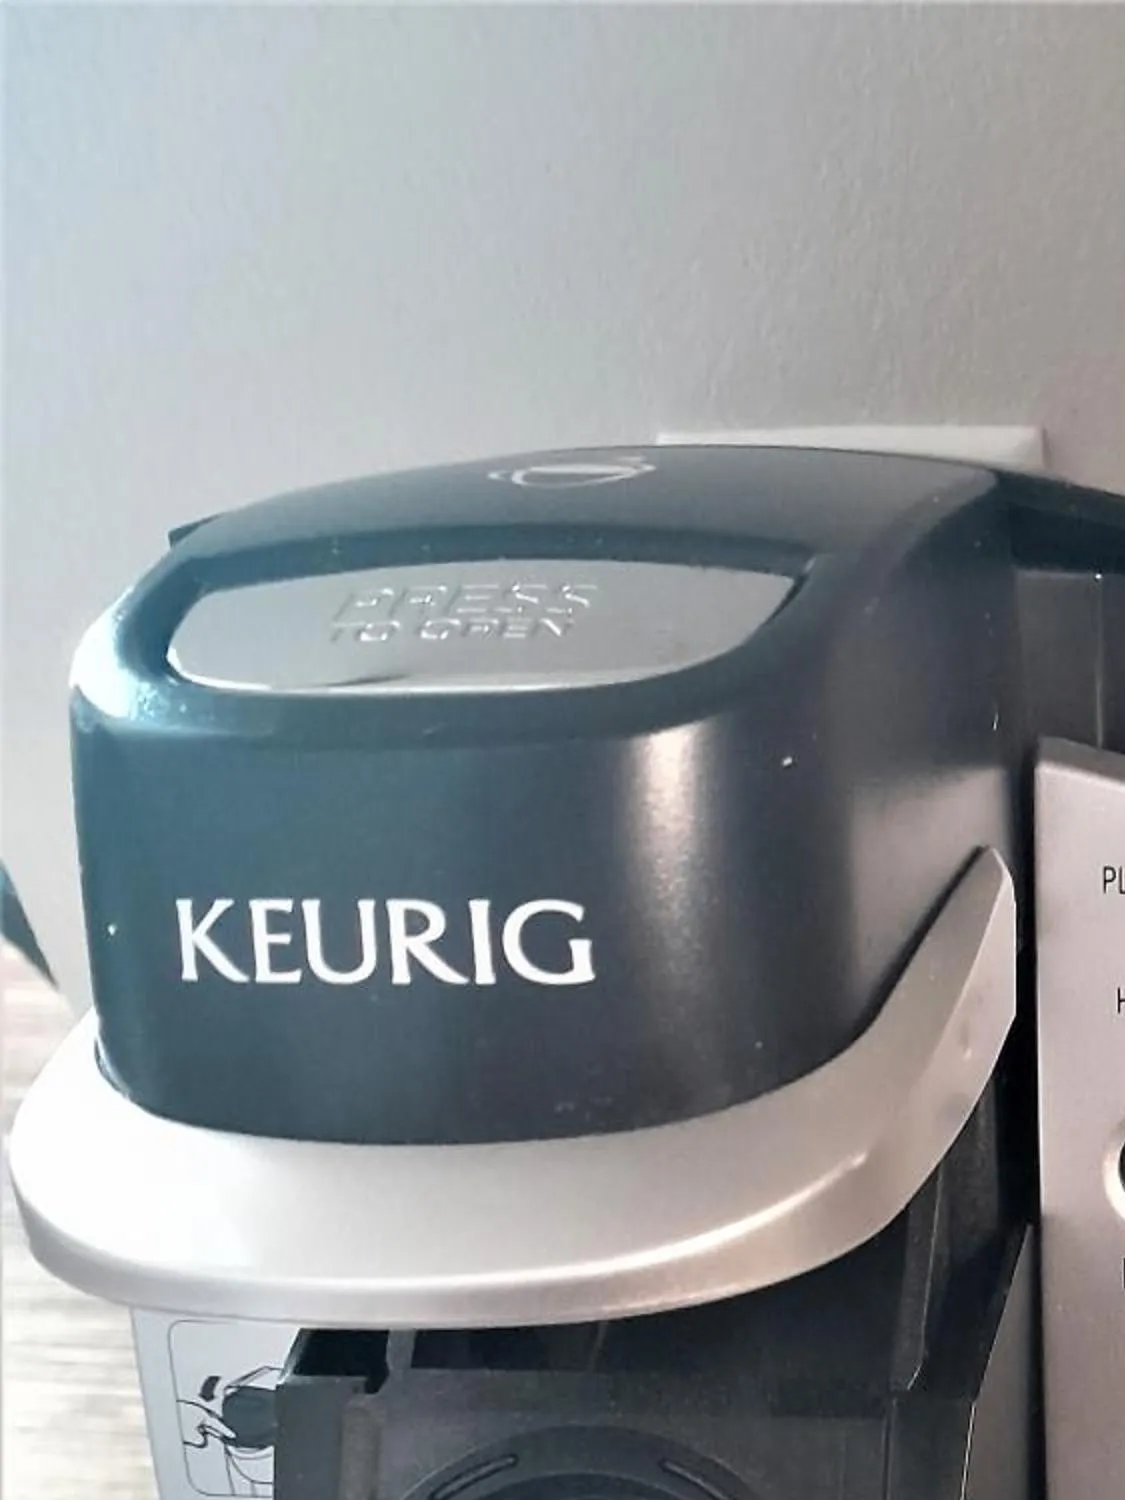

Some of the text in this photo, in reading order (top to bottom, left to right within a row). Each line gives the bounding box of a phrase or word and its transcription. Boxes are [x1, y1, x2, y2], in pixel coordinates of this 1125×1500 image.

[331, 582, 598, 622] PRESS
[330, 617, 574, 643] TO OPEN
[175, 898, 596, 985] KEURIG
